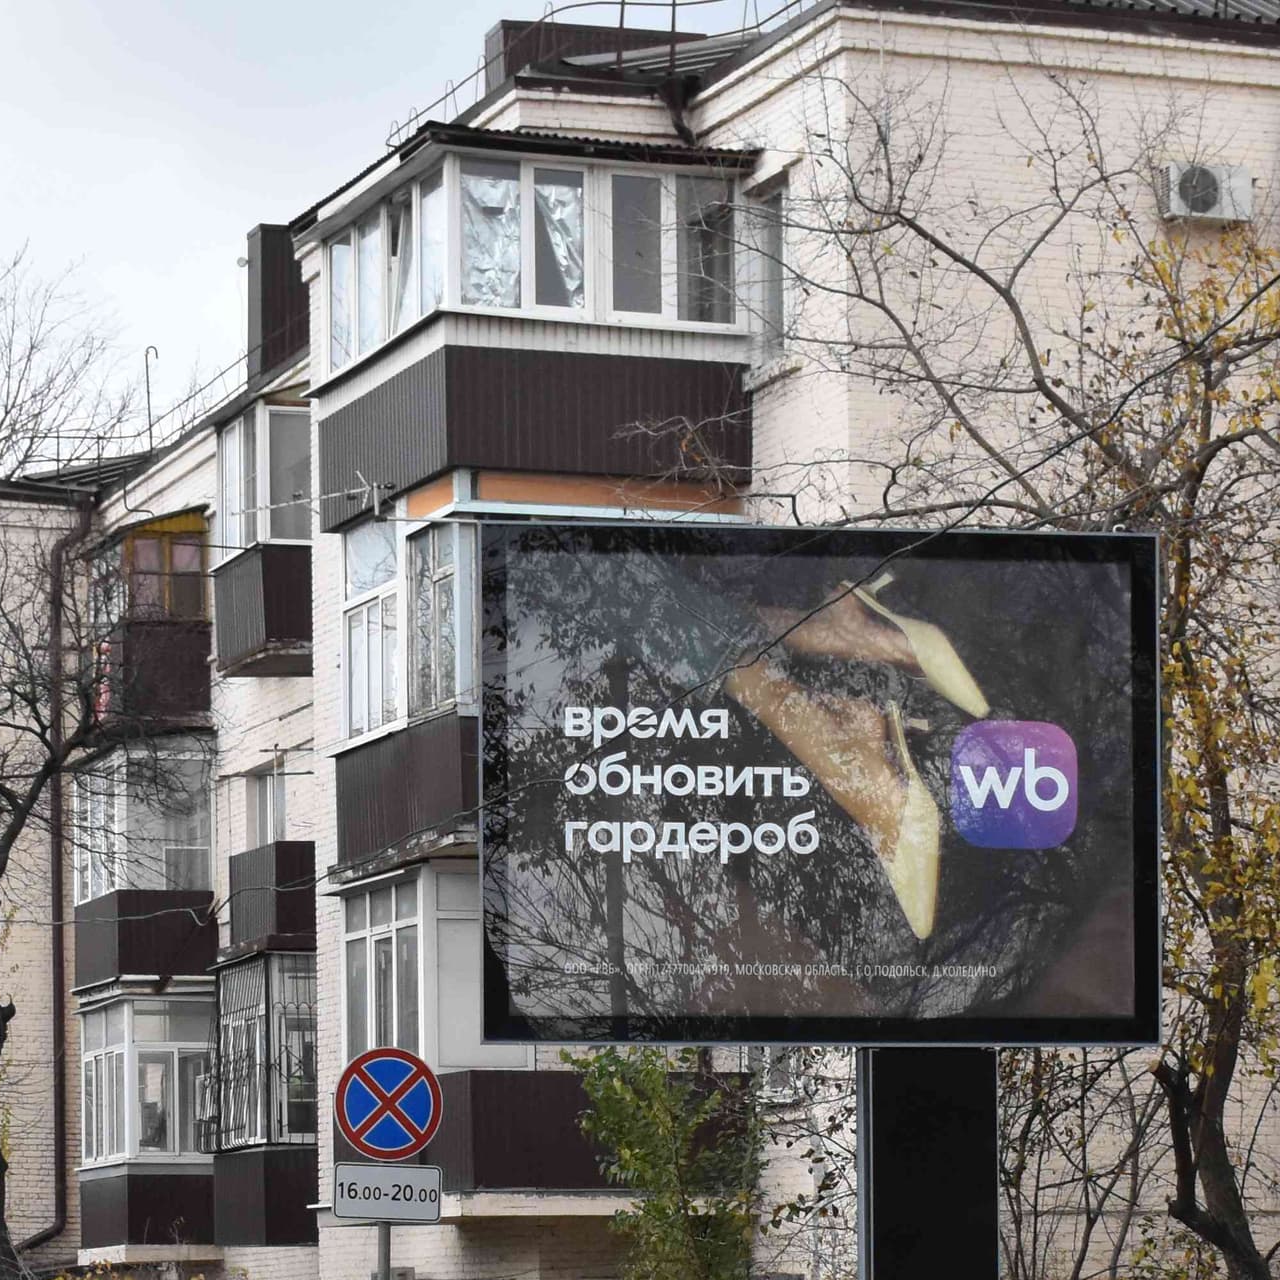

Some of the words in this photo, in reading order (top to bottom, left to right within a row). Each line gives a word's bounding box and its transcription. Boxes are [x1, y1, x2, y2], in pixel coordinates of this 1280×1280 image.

[565, 706, 729, 747] время
[564, 751, 810, 798] обновить
[959, 748, 1069, 811] wb
[564, 810, 820, 865] гардероб
[735, 963, 802, 976] МОСКОВСКАЯ
[337, 1182, 438, 1203] 16.00-20.00
